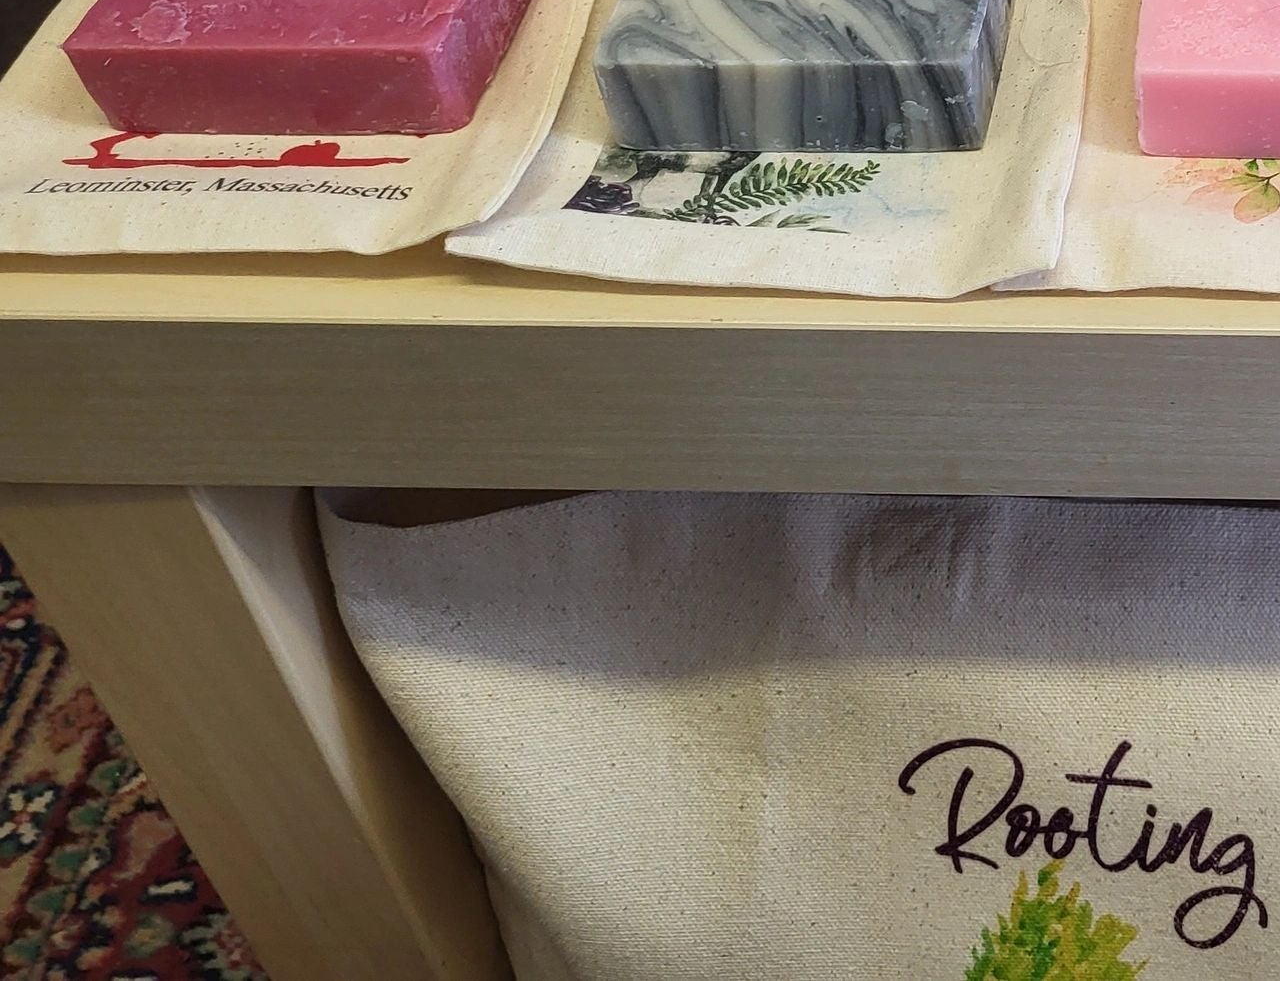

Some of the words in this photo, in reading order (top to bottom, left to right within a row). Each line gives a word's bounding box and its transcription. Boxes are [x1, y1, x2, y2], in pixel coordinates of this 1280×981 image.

[25, 177, 197, 195] Leominster,
[203, 177, 414, 201] Massachusetts
[899, 738, 1269, 950] Rooting
